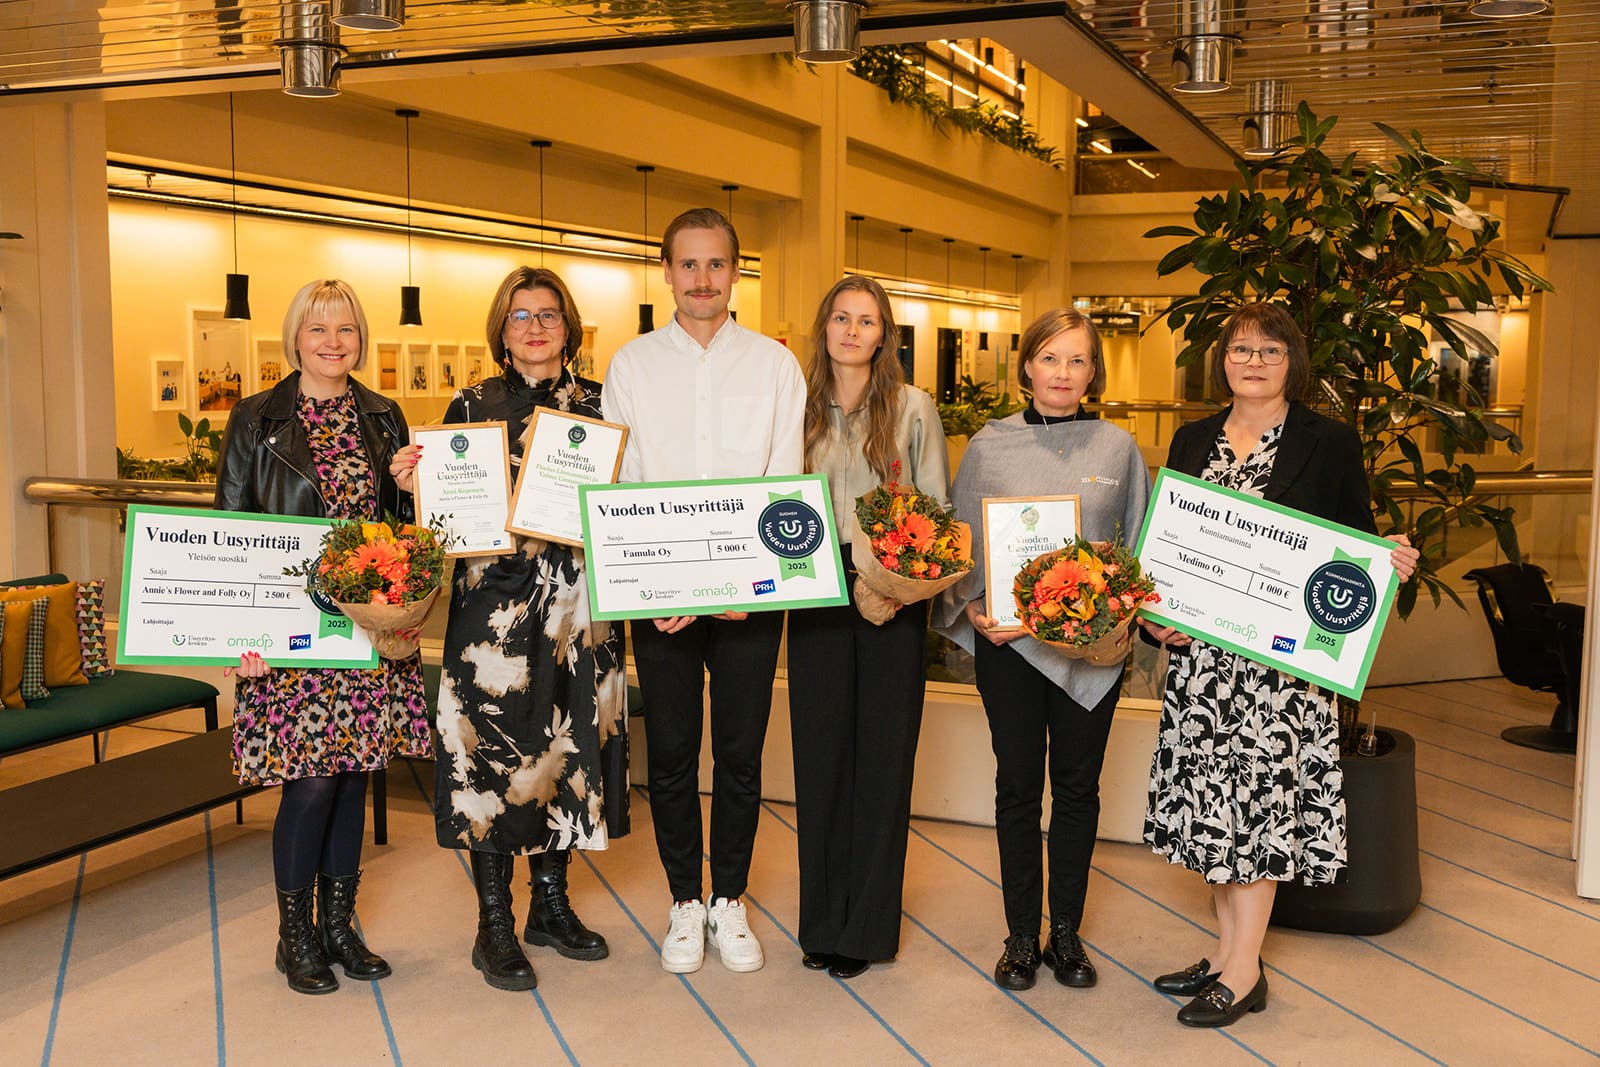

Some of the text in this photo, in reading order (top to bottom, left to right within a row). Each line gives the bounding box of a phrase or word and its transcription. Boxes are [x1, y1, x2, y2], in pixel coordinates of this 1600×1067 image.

[557, 448, 590, 463] Vuoden
[444, 462, 478, 472] Vuoden
[546, 454, 596, 473] Uusyrittäjä
[597, 498, 745, 517] Vuoden Uusyrittäjä
[1168, 491, 1310, 551] Vuoden Uusyrittäjä
[146, 526, 300, 553] Vuoden Uusyrittäjä
[765, 520, 818, 551] Vuoden Uusyrittäjä
[1199, 524, 1252, 549] Kunniamaininta
[623, 548, 672, 559] Famula Oy
[717, 543, 748, 553] 5 000 €
[188, 552, 248, 564] Yleisön suosikki
[1176, 551, 1226, 577] Medimo Oy
[149, 567, 168, 576] Saaja
[787, 562, 808, 570] 2025
[174, 587, 201, 597] Flower
[202, 588, 217, 597] and
[218, 588, 238, 600] Folly
[239, 589, 253, 600] Oy
[754, 583, 774, 592] PRH
[1259, 581, 1291, 599] 1 000 €
[264, 591, 292, 600] 2 500 €
[1312, 580, 1369, 625] Vuoden Uusyrittäjä
[327, 620, 347, 628] 2025
[290, 637, 310, 648] PRH
[1273, 638, 1294, 652] PRH
[1315, 633, 1337, 647] 2025
